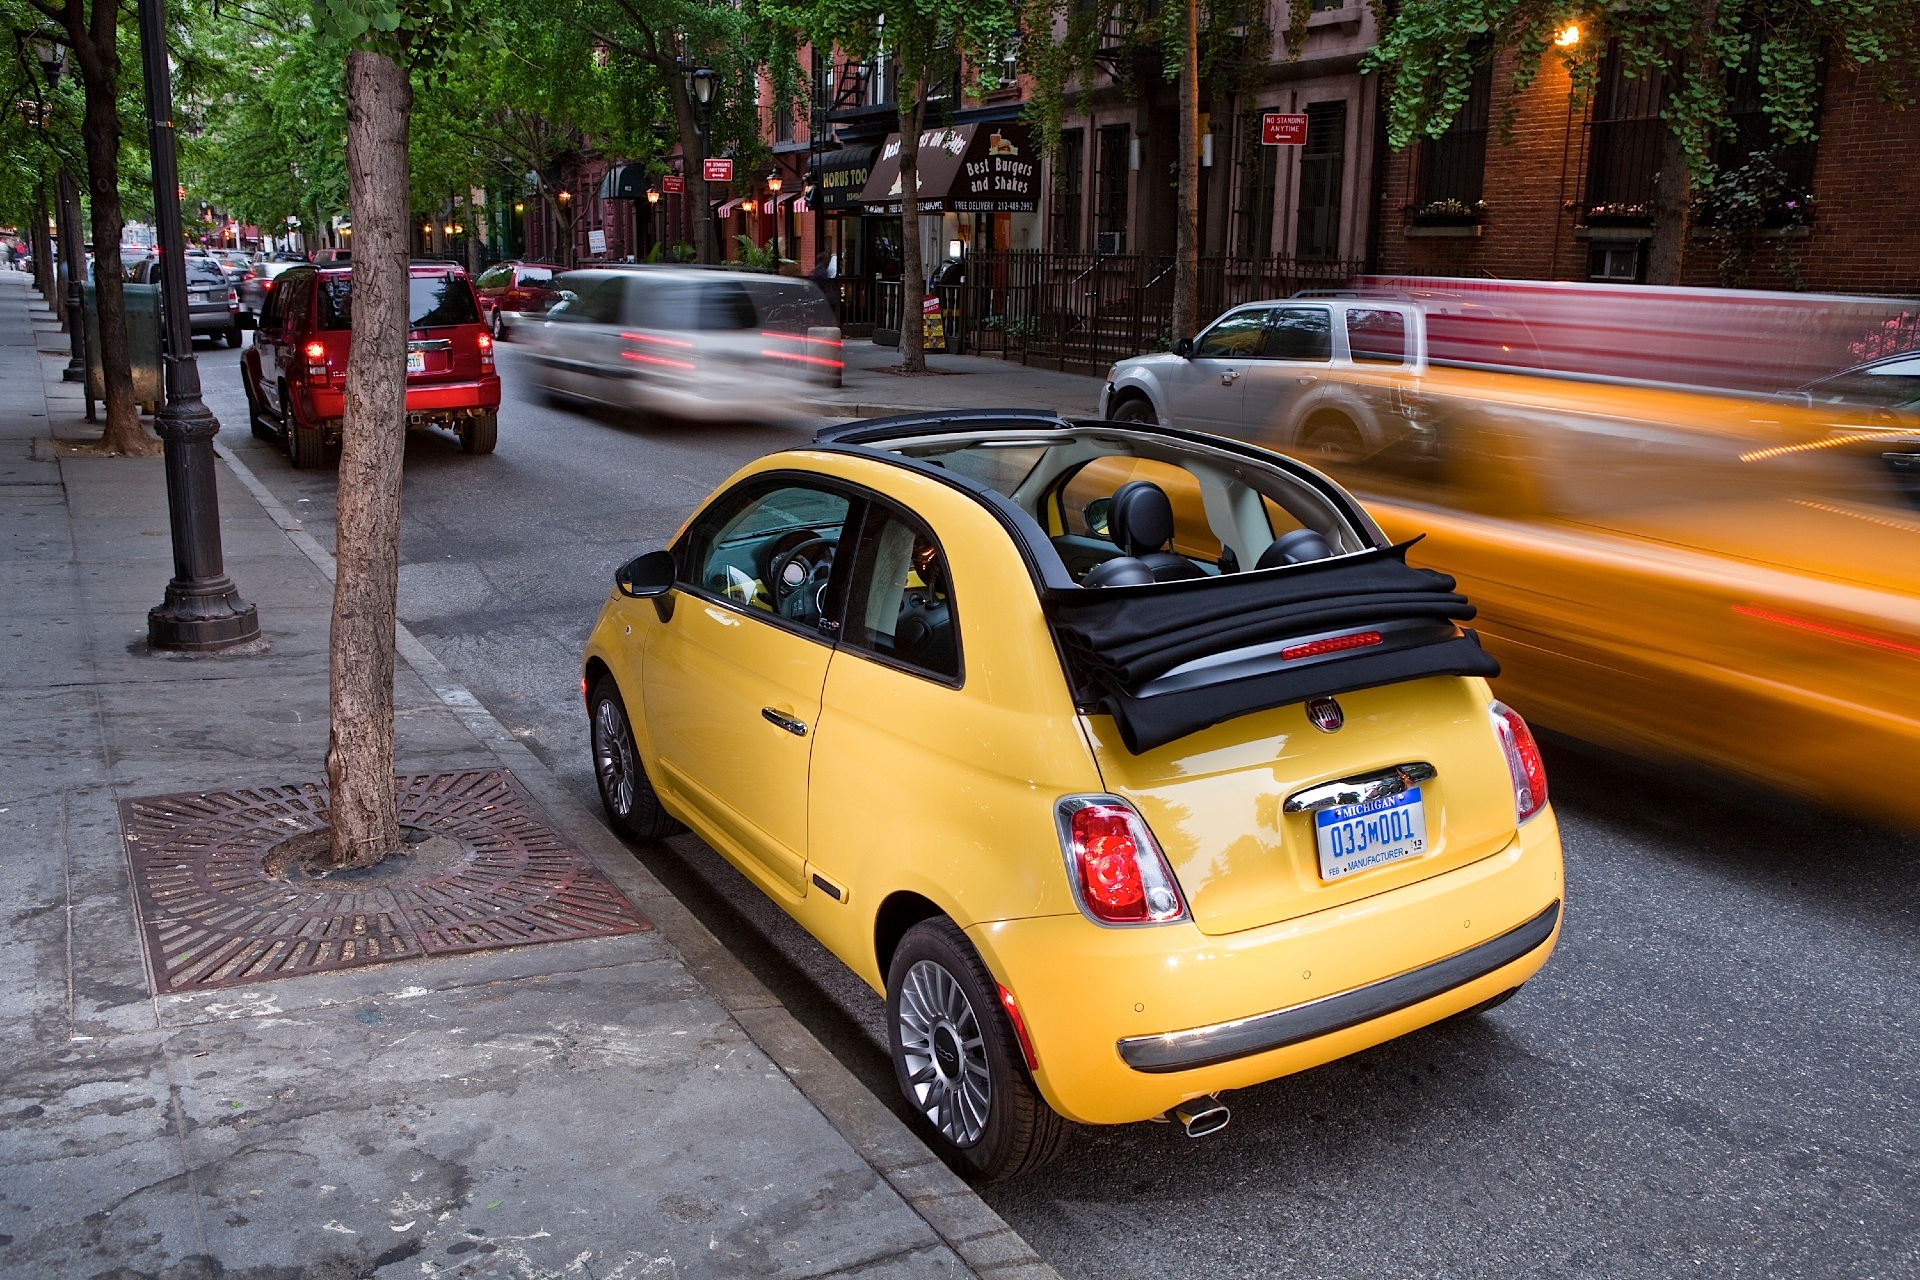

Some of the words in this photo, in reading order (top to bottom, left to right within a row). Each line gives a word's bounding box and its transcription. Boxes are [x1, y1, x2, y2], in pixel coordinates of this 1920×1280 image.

[882, 139, 901, 161] Best
[966, 158, 989, 177] Best
[995, 157, 1033, 177] Burgers
[822, 170, 849, 188] HORUS
[850, 167, 868, 185] TOO
[971, 177, 989, 193] and
[994, 176, 1029, 193] Shakes
[955, 201, 968, 210] FREE
[968, 201, 994, 211] DELIVERY
[997, 201, 1033, 211] 212-489-2992
[1315, 703, 1337, 722] FIAT
[1343, 795, 1397, 818] MICHIGAN
[1330, 808, 1415, 858] 033M001
[1347, 847, 1404, 871] MANUFACTURER
[1328, 867, 1340, 876] FEB
